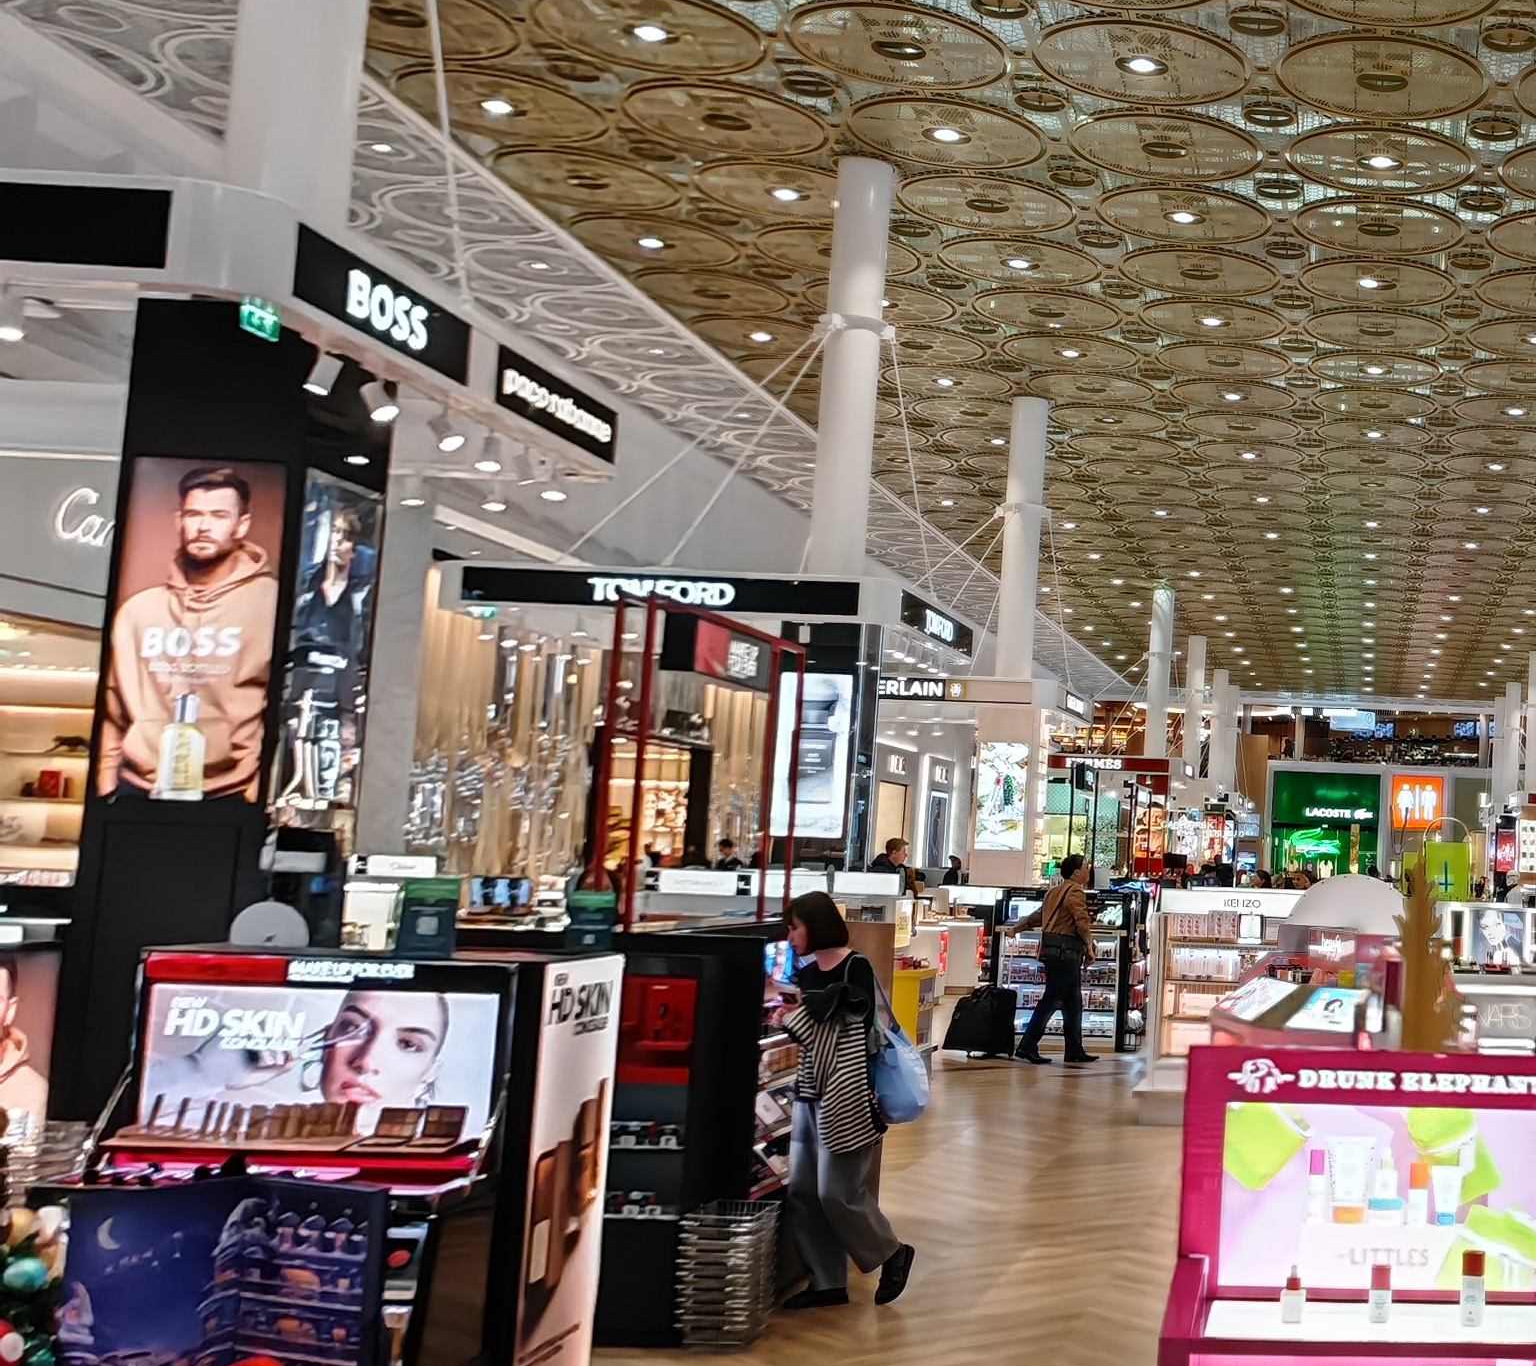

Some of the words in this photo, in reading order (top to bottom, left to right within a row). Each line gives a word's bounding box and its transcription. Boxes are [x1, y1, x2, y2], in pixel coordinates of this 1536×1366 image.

[346, 268, 428, 350] BOSS
[141, 626, 242, 657] BOSS
[1305, 808, 1351, 819] LACOSTE
[1223, 898, 1261, 909] KENZO
[170, 996, 208, 1008] NEW
[164, 1008, 220, 1036] HD
[218, 1009, 306, 1038] SKIN
[1477, 1003, 1531, 1030] NARS
[1298, 1069, 1395, 1091] DRUNK
[1349, 1247, 1429, 1267] LITTLES
